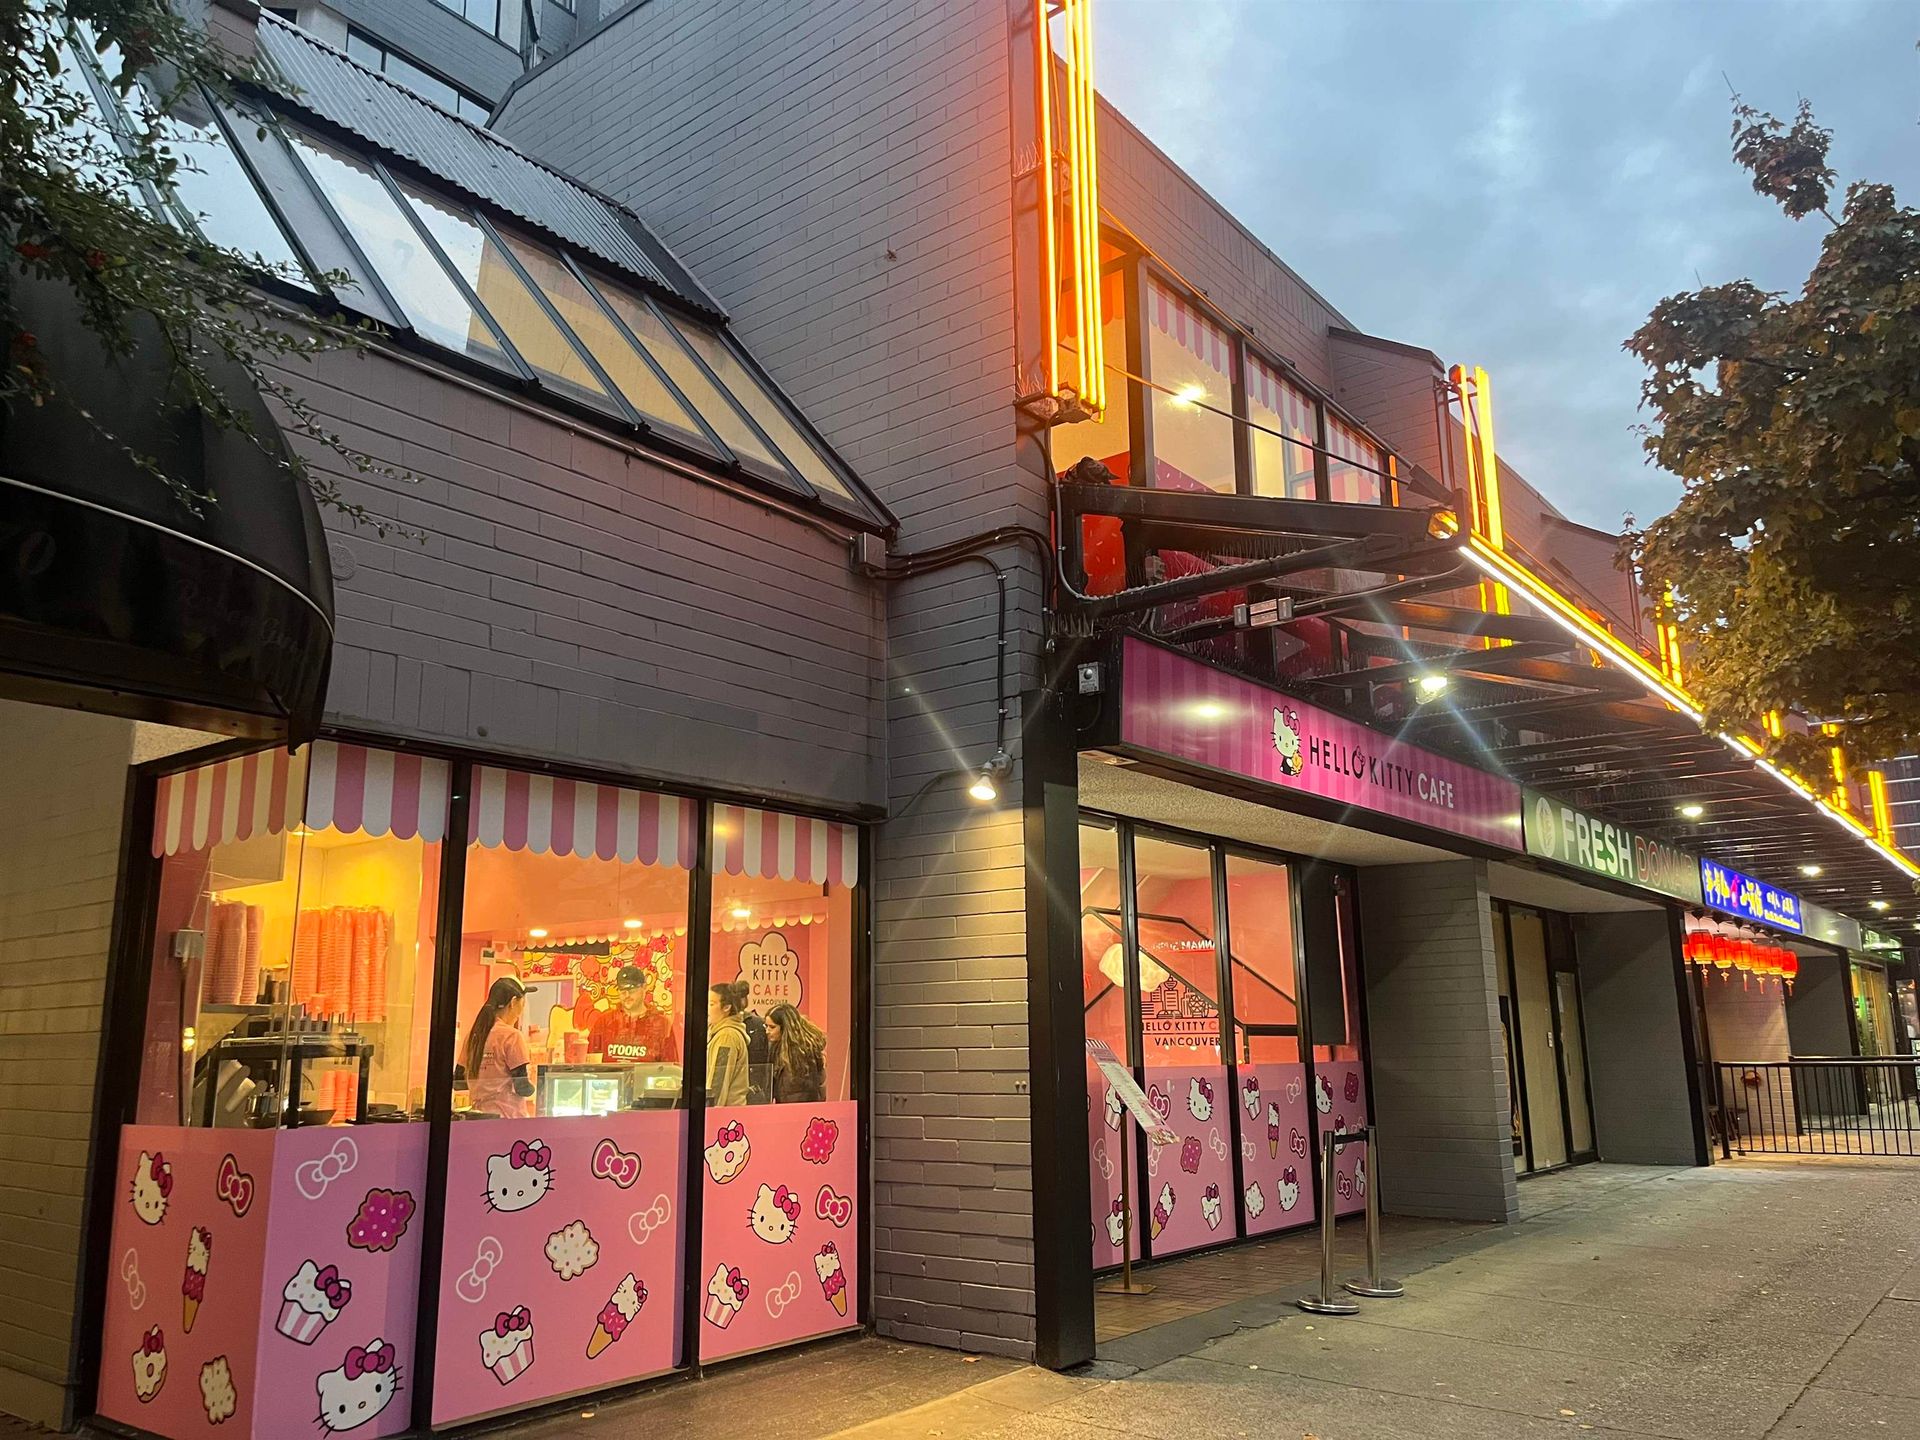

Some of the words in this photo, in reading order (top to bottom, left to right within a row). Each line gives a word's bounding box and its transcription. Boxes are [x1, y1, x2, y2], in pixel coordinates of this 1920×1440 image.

[1309, 735, 1365, 779] HELLO
[1369, 756, 1414, 795] KITTY
[1417, 773, 1454, 808] CAFE
[1560, 807, 1633, 879] FRESH
[753, 954, 789, 966] HELLO
[753, 969, 788, 981] KITTY
[753, 984, 788, 996] CAFE
[1143, 1020, 1172, 1031] ELLO
[1175, 1021, 1206, 1031] KITTY
[1154, 1037, 1221, 1046] VANCOUVER
